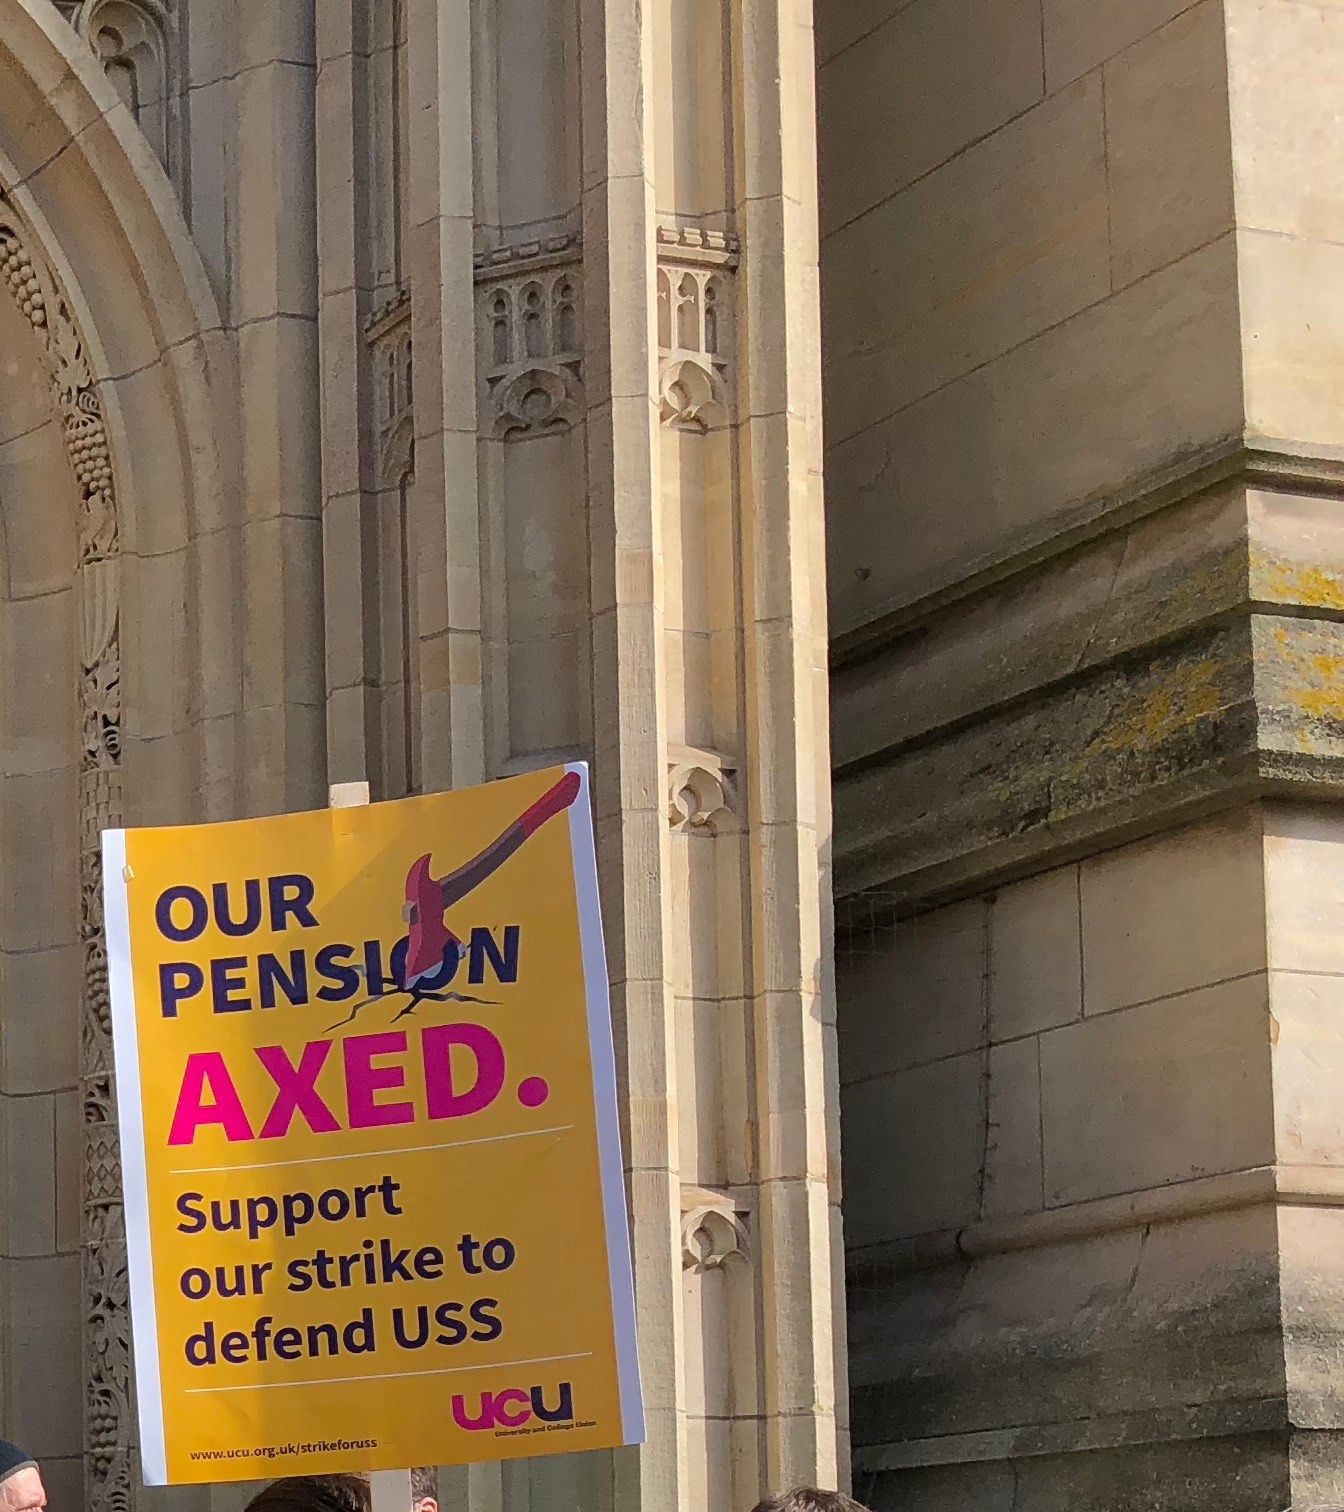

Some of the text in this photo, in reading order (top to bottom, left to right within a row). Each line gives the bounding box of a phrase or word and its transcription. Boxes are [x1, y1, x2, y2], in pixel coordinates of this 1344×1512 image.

[155, 873, 320, 941] OUR
[159, 925, 520, 1018] PENSION
[167, 1022, 549, 1146] AXED.
[176, 1175, 403, 1239] Support
[180, 1234, 515, 1300] our strike to
[185, 1298, 503, 1367] defend USS
[190, 1438, 378, 1460] www.ucu.org.uk/strikeforuss
